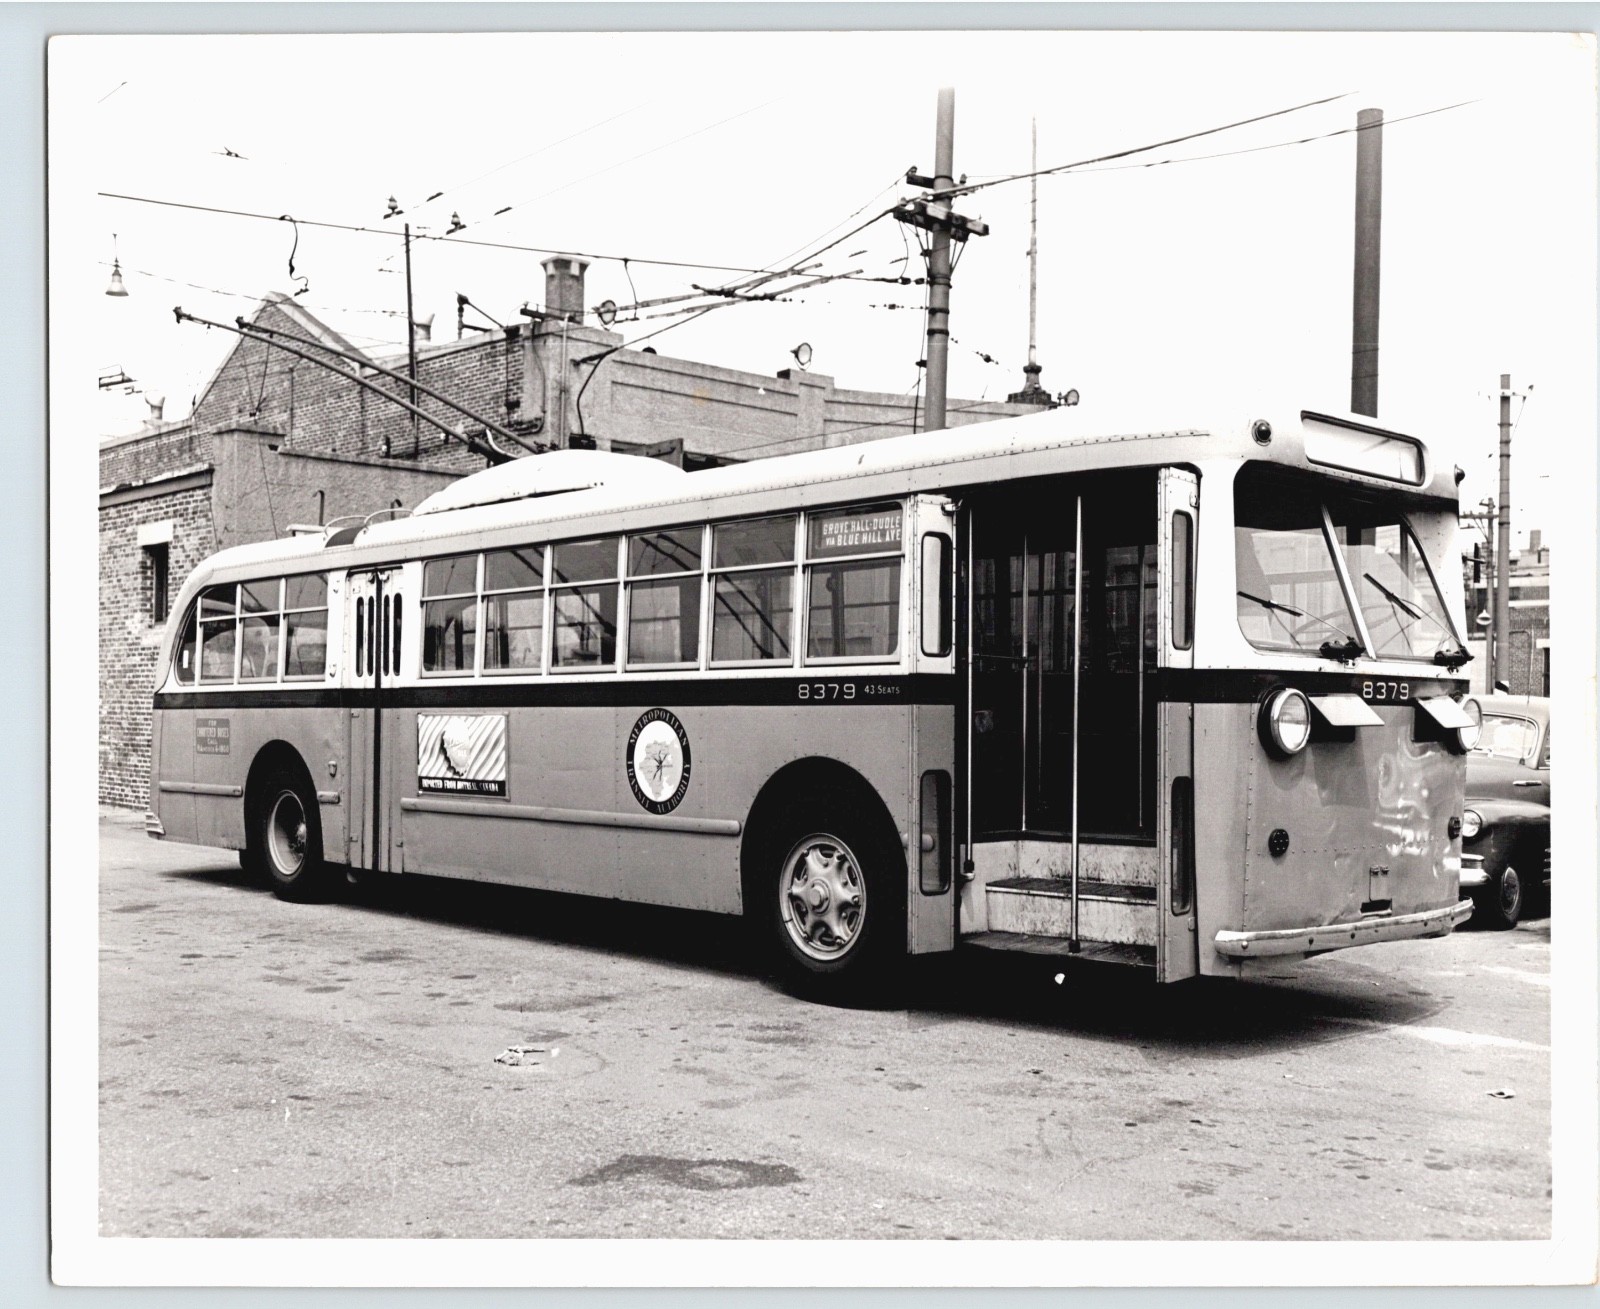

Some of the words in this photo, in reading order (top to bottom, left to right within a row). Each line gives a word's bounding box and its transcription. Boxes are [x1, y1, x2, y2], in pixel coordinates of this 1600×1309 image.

[823, 521, 849, 535] GROVE
[826, 537, 835, 546] VIA
[837, 533, 860, 546] BLUE
[862, 530, 882, 544] HILL
[885, 528, 901, 542] AVE
[798, 683, 856, 699] 8379
[864, 685, 876, 694] 43
[1362, 681, 1409, 700] 8379
[629, 709, 688, 746] METROPOLITAN
[627, 761, 650, 808] TRANSIT
[657, 763, 690, 814] AUTHORITY
